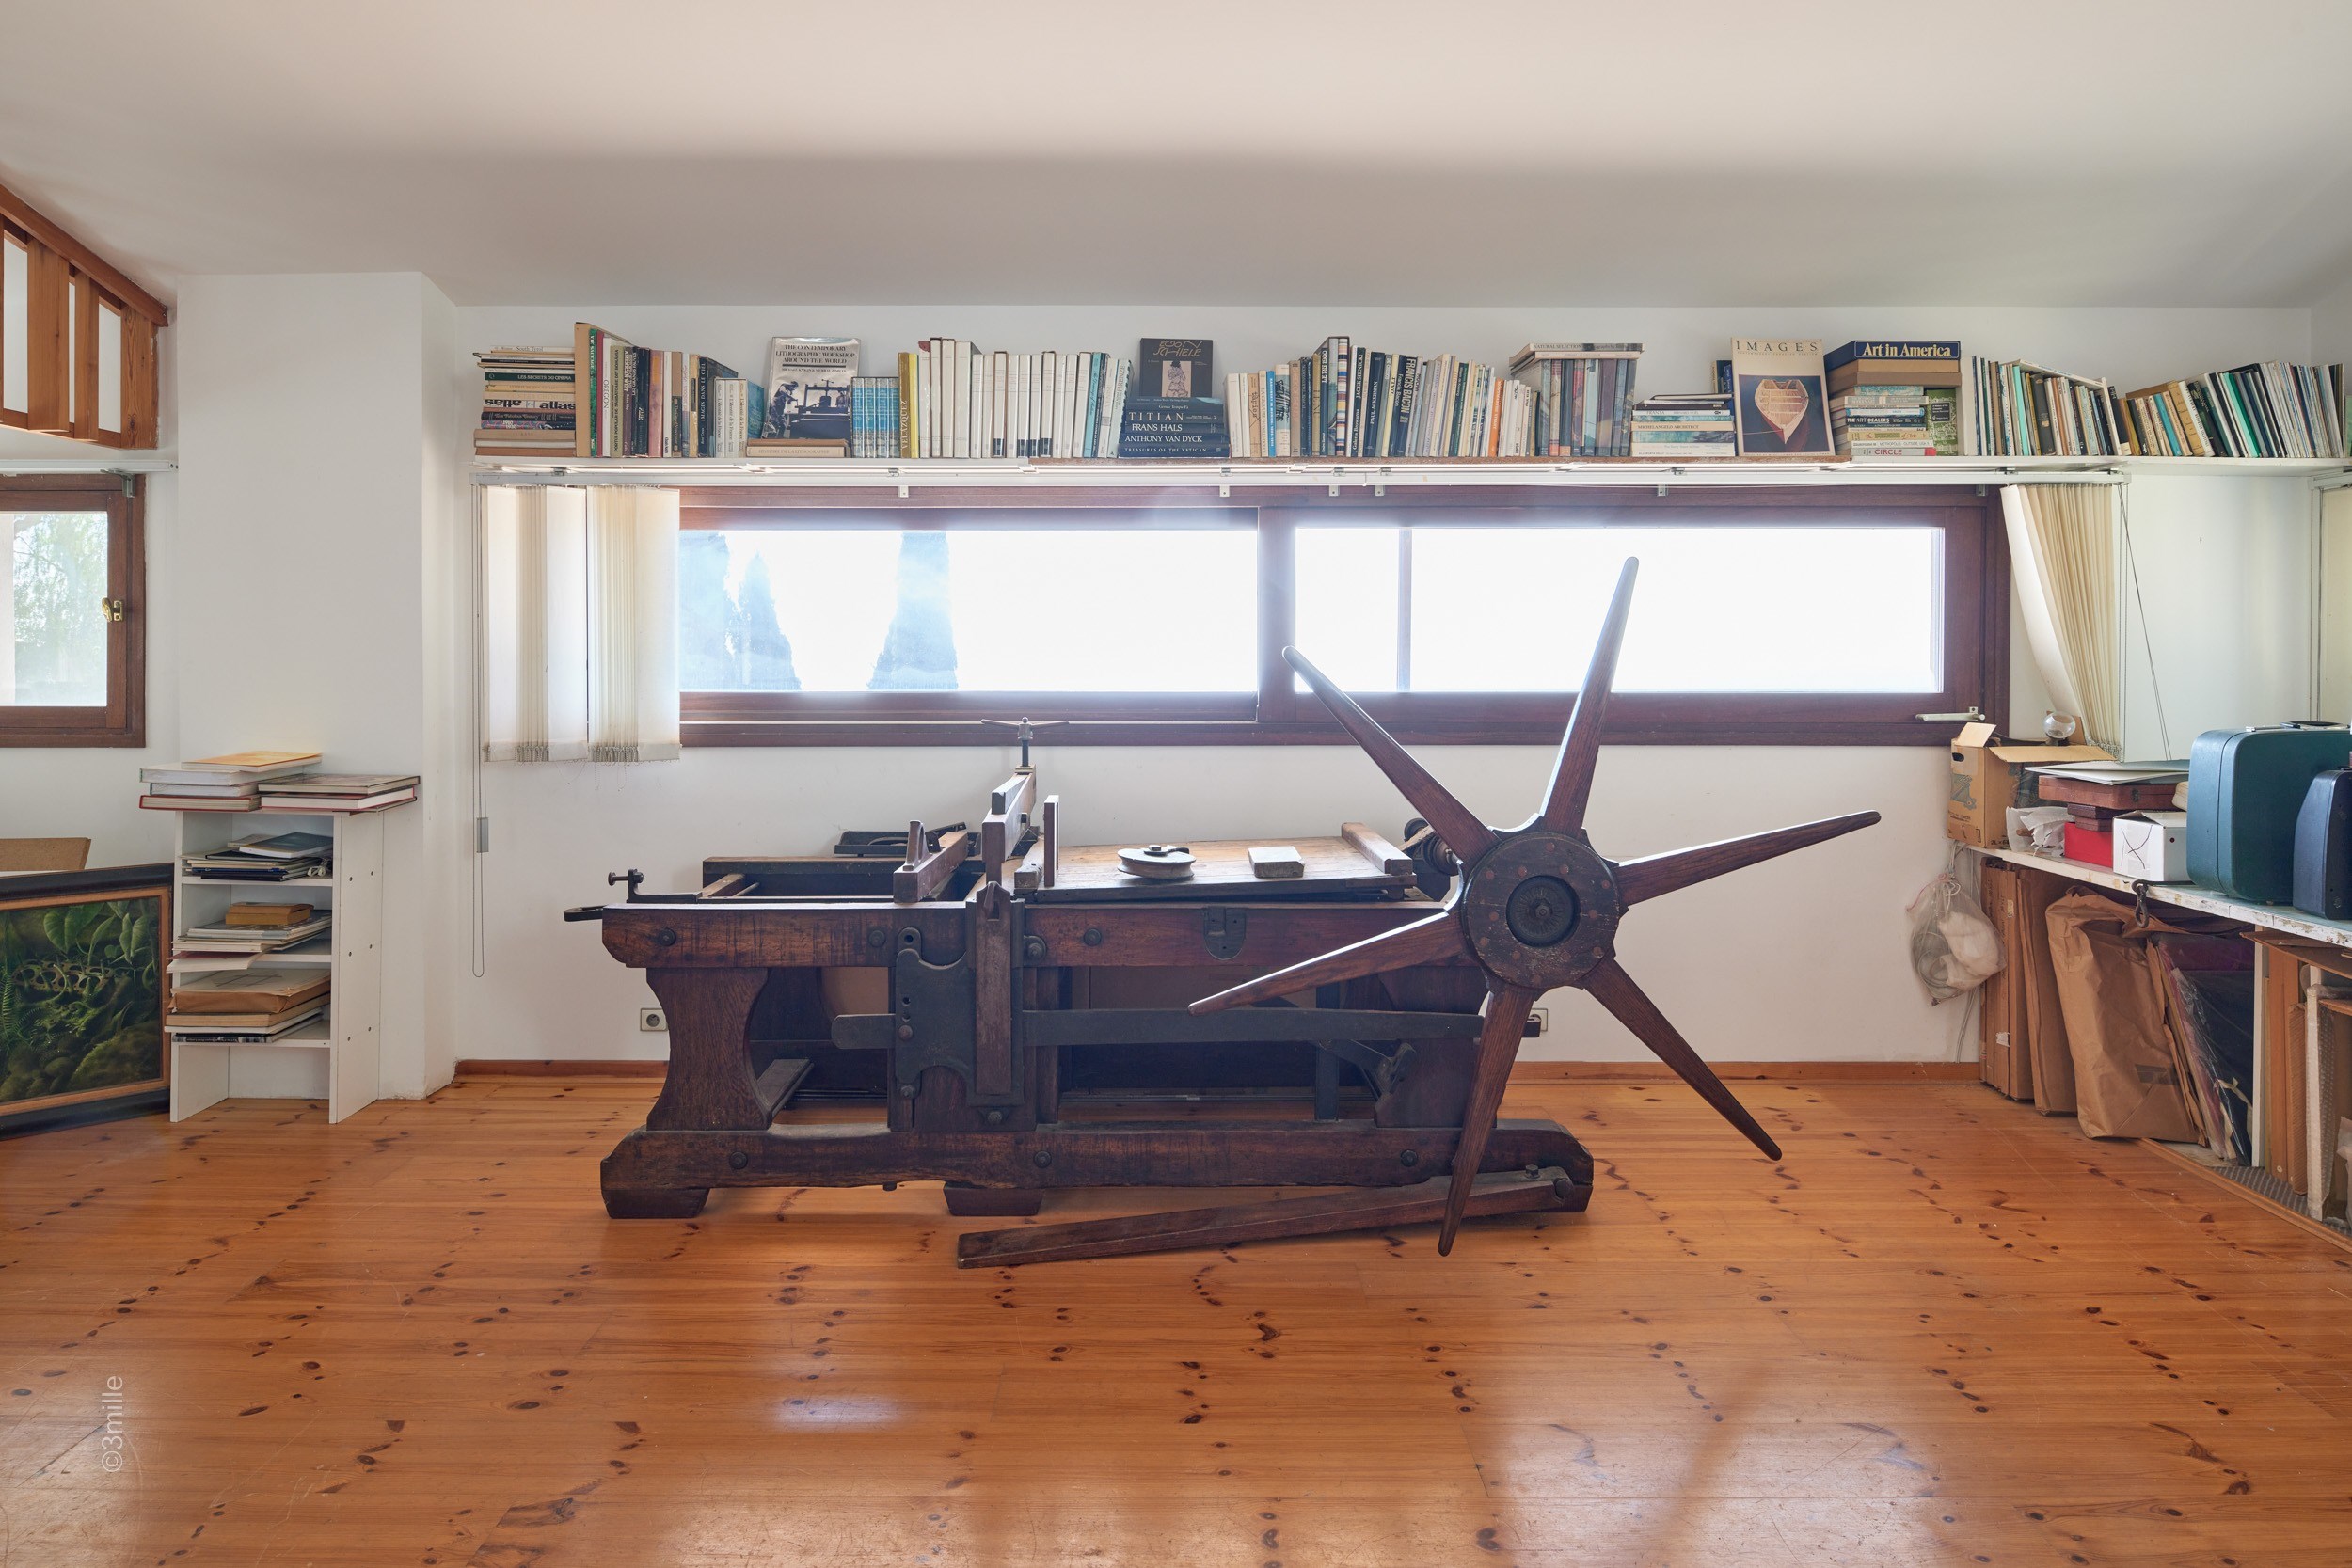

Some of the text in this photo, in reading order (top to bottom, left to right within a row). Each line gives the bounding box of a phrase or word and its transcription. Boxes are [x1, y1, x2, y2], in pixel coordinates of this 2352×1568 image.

[1159, 339, 1203, 349] EGON
[1736, 341, 1819, 352] IMAGES
[1862, 341, 1951, 357] Art in America
[1155, 346, 1203, 357] SCHIELE
[1117, 365, 1126, 392] FIRENZE
[1321, 374, 1327, 383] LE
[1404, 358, 1417, 388] FRANCIS
[1370, 380, 1378, 411] ACKERMAN
[1400, 388, 1412, 413] BACON
[539, 401, 576, 410] atlas
[1128, 411, 1184, 421] TITIAN
[900, 400, 909, 450] VELAZQUEZ
[1132, 423, 1183, 432] FRANS HALS
[1124, 435, 1203, 443] ANTHONY VAN DYCK
